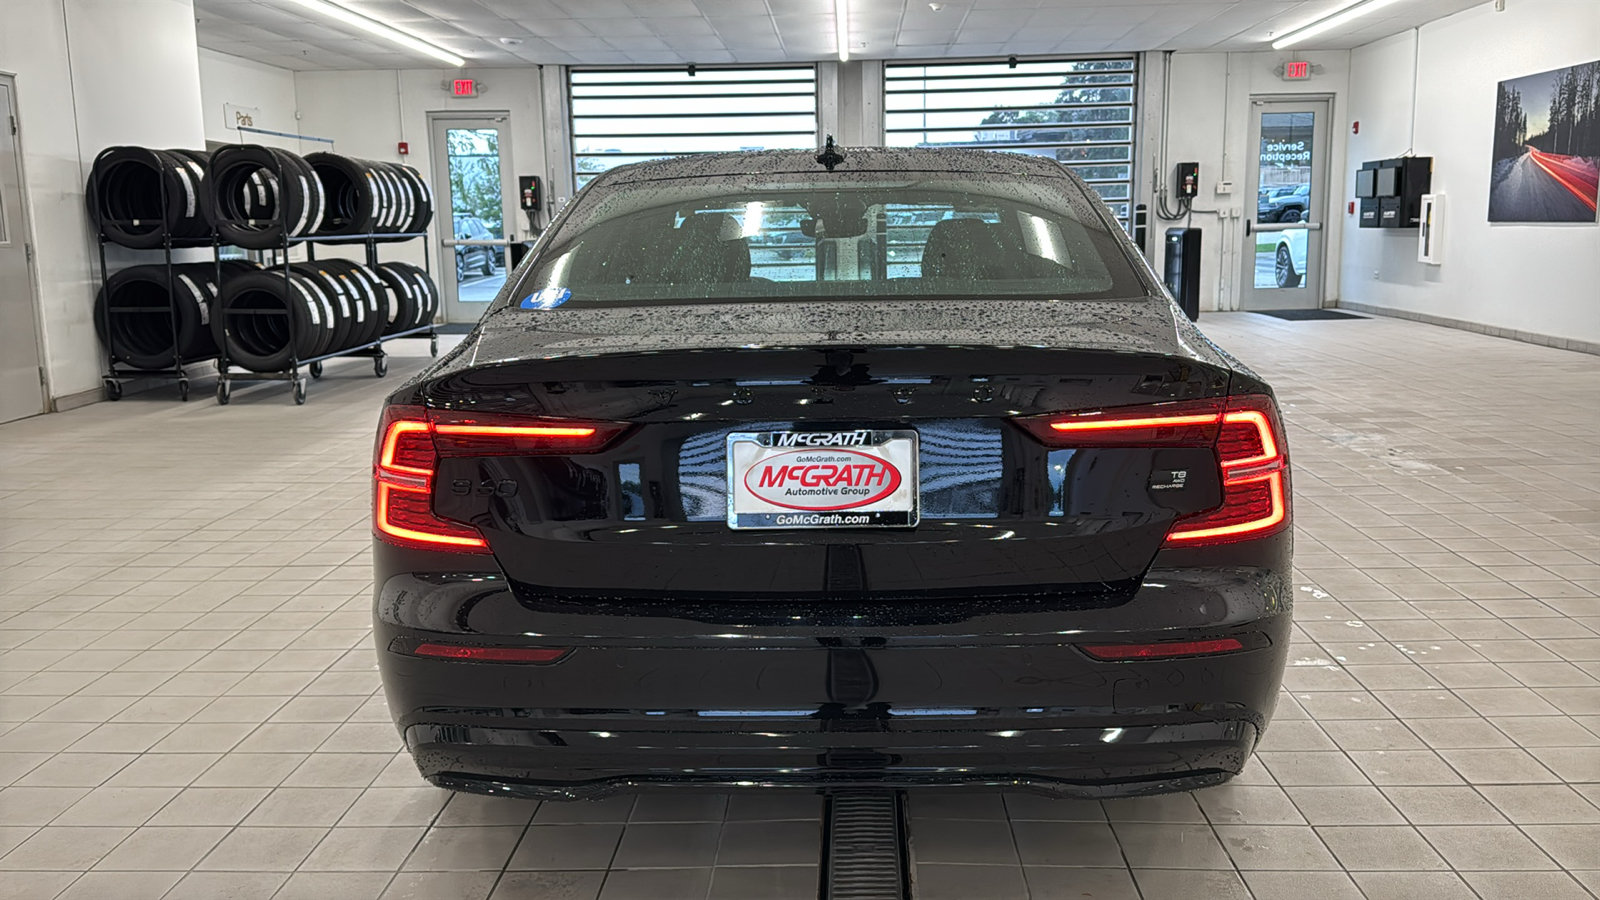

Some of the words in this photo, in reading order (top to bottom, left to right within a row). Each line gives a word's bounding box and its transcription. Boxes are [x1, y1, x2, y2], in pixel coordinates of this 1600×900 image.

[1288, 62, 1307, 77] EXIT
[454, 79, 473, 95] EXIT
[236, 111, 253, 126] Parts
[1171, 471, 1187, 479] T8
[785, 487, 838, 496] Automotive
[841, 487, 870, 497] Group
[776, 514, 870, 526] GoMcGrath.com
